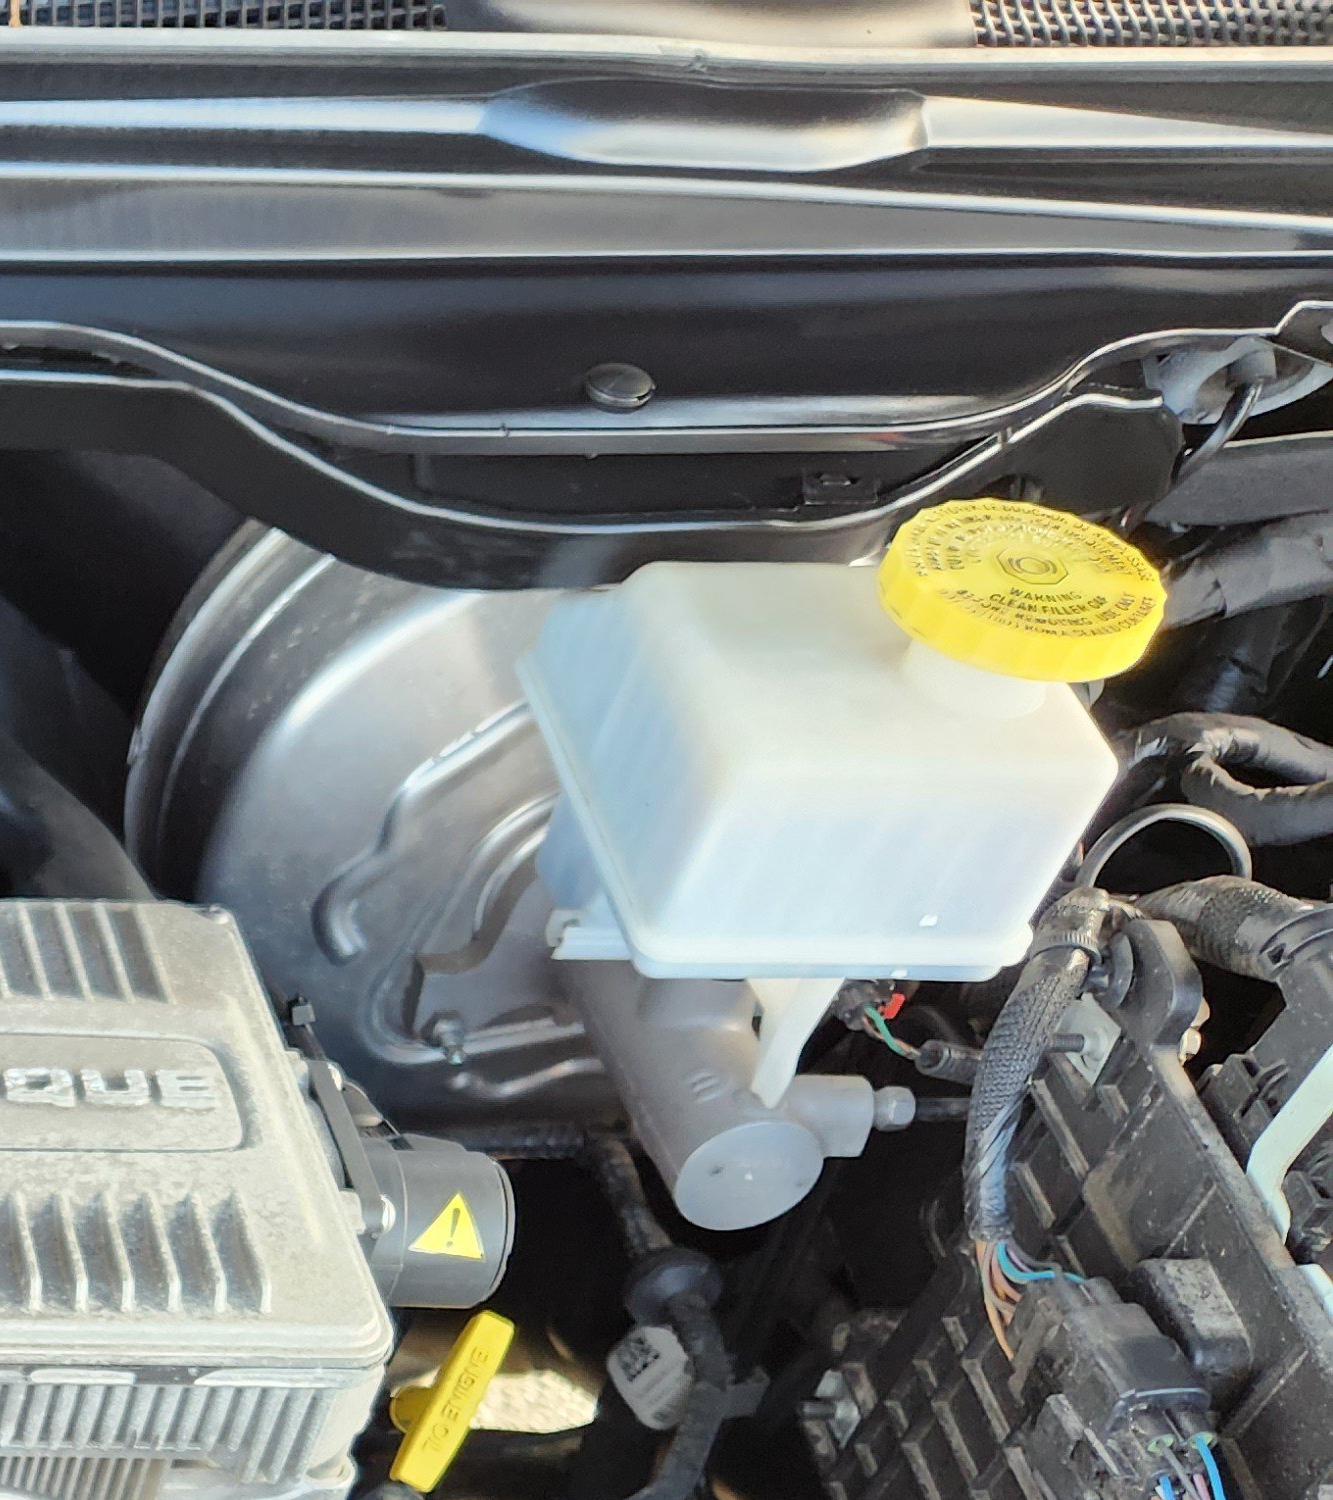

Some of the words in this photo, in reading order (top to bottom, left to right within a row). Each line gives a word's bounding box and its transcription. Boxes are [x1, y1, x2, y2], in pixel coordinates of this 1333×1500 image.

[989, 593, 1038, 613] CLEAN
[1042, 603, 1087, 616] FILLER
[1087, 595, 1108, 610] CAP
[1009, 587, 1083, 603] WARNING
[440, 1346, 490, 1423] ENGINE
[420, 1425, 450, 1454] OIL
